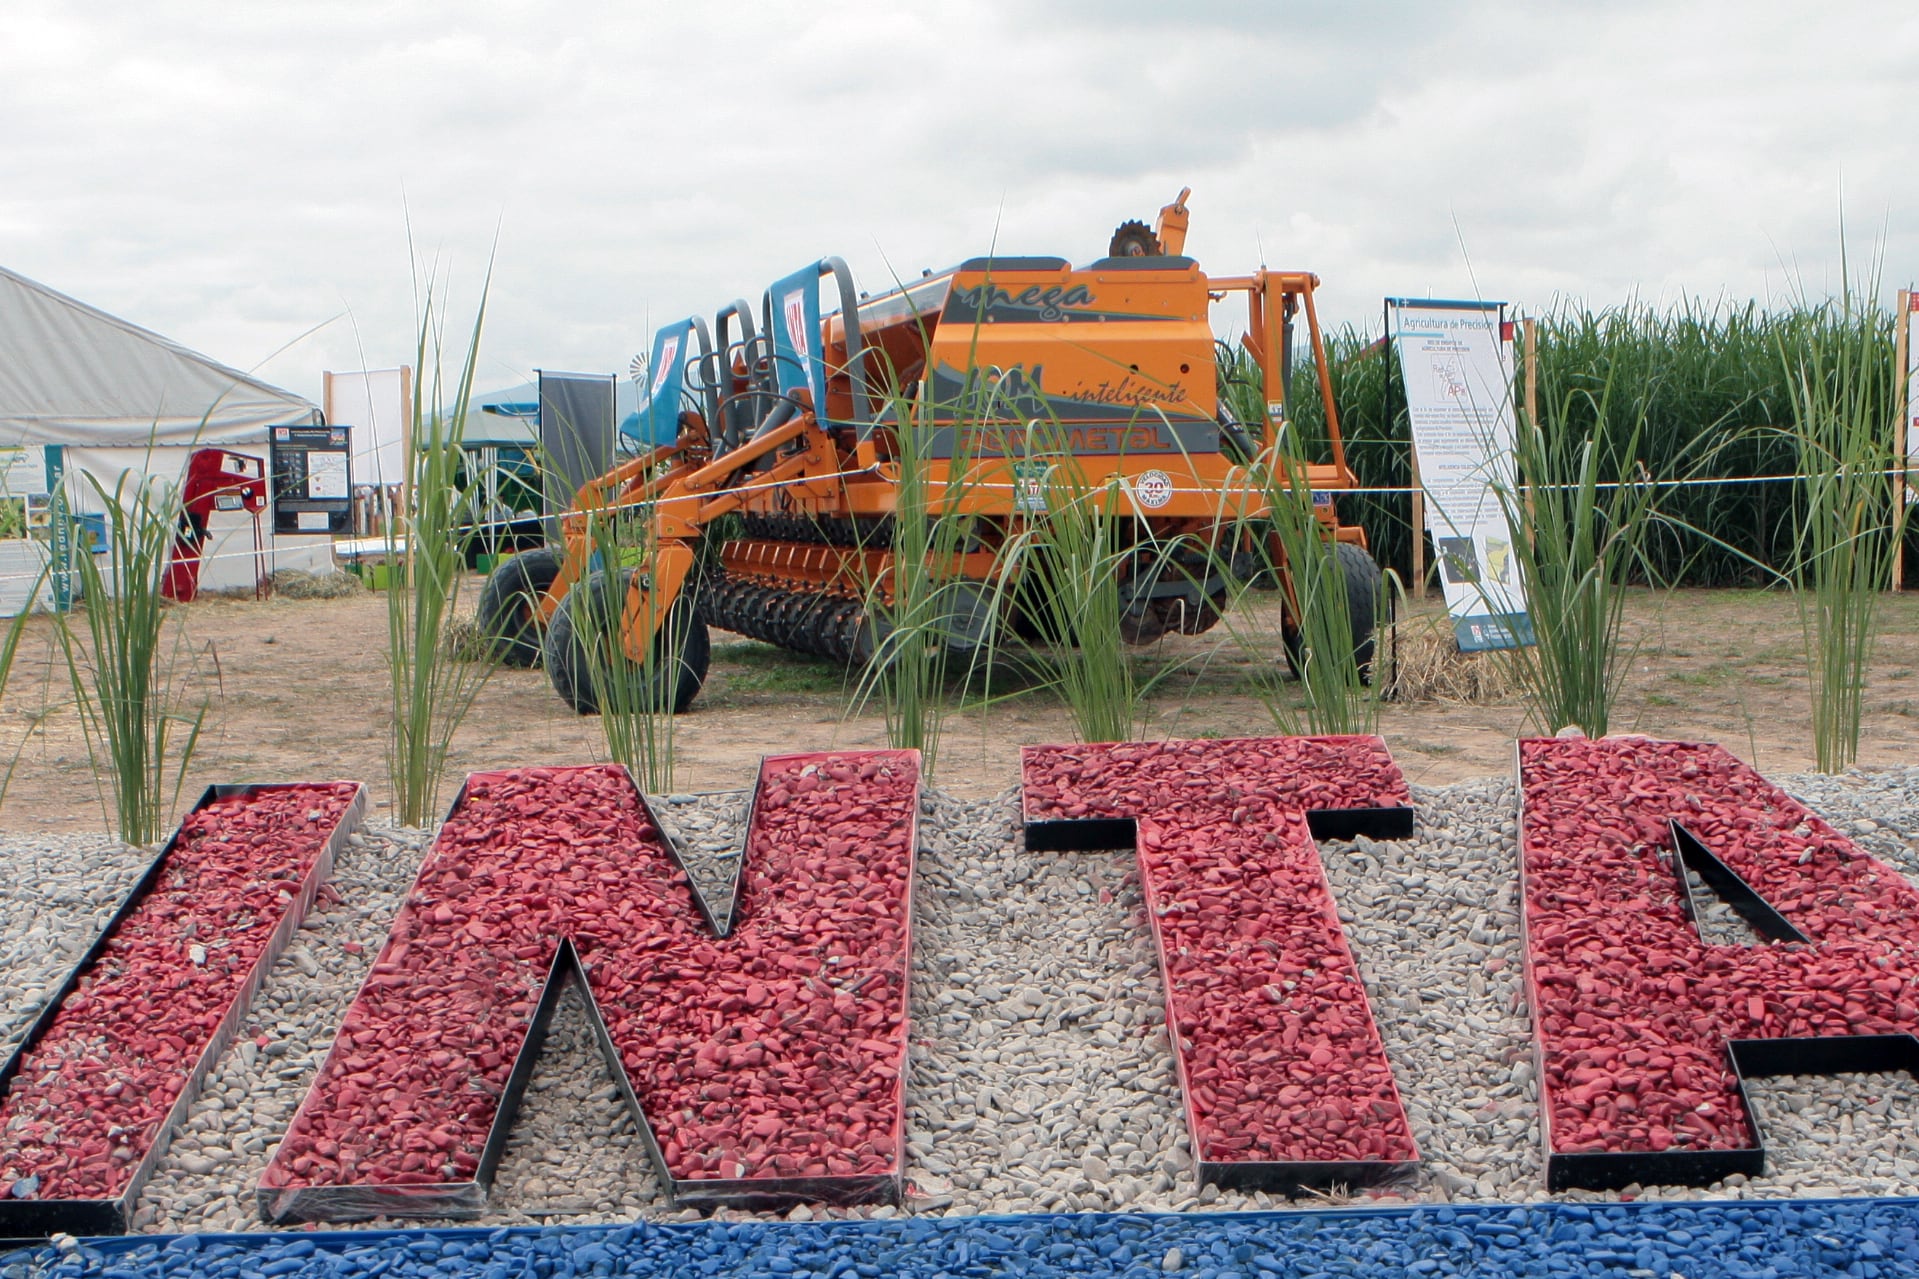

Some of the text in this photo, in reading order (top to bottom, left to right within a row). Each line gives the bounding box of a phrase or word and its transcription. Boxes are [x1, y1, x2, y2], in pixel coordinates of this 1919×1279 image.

[961, 283, 1096, 322] mega
[785, 300, 808, 355] INTA
[1404, 316, 1494, 331] Agricultura de Precisión
[1071, 376, 1187, 409] inteligente
[1138, 470, 1169, 487] VELOCIDAD
[1144, 481, 1165, 494] 30
[0, 732, 1919, 1243] INTA
